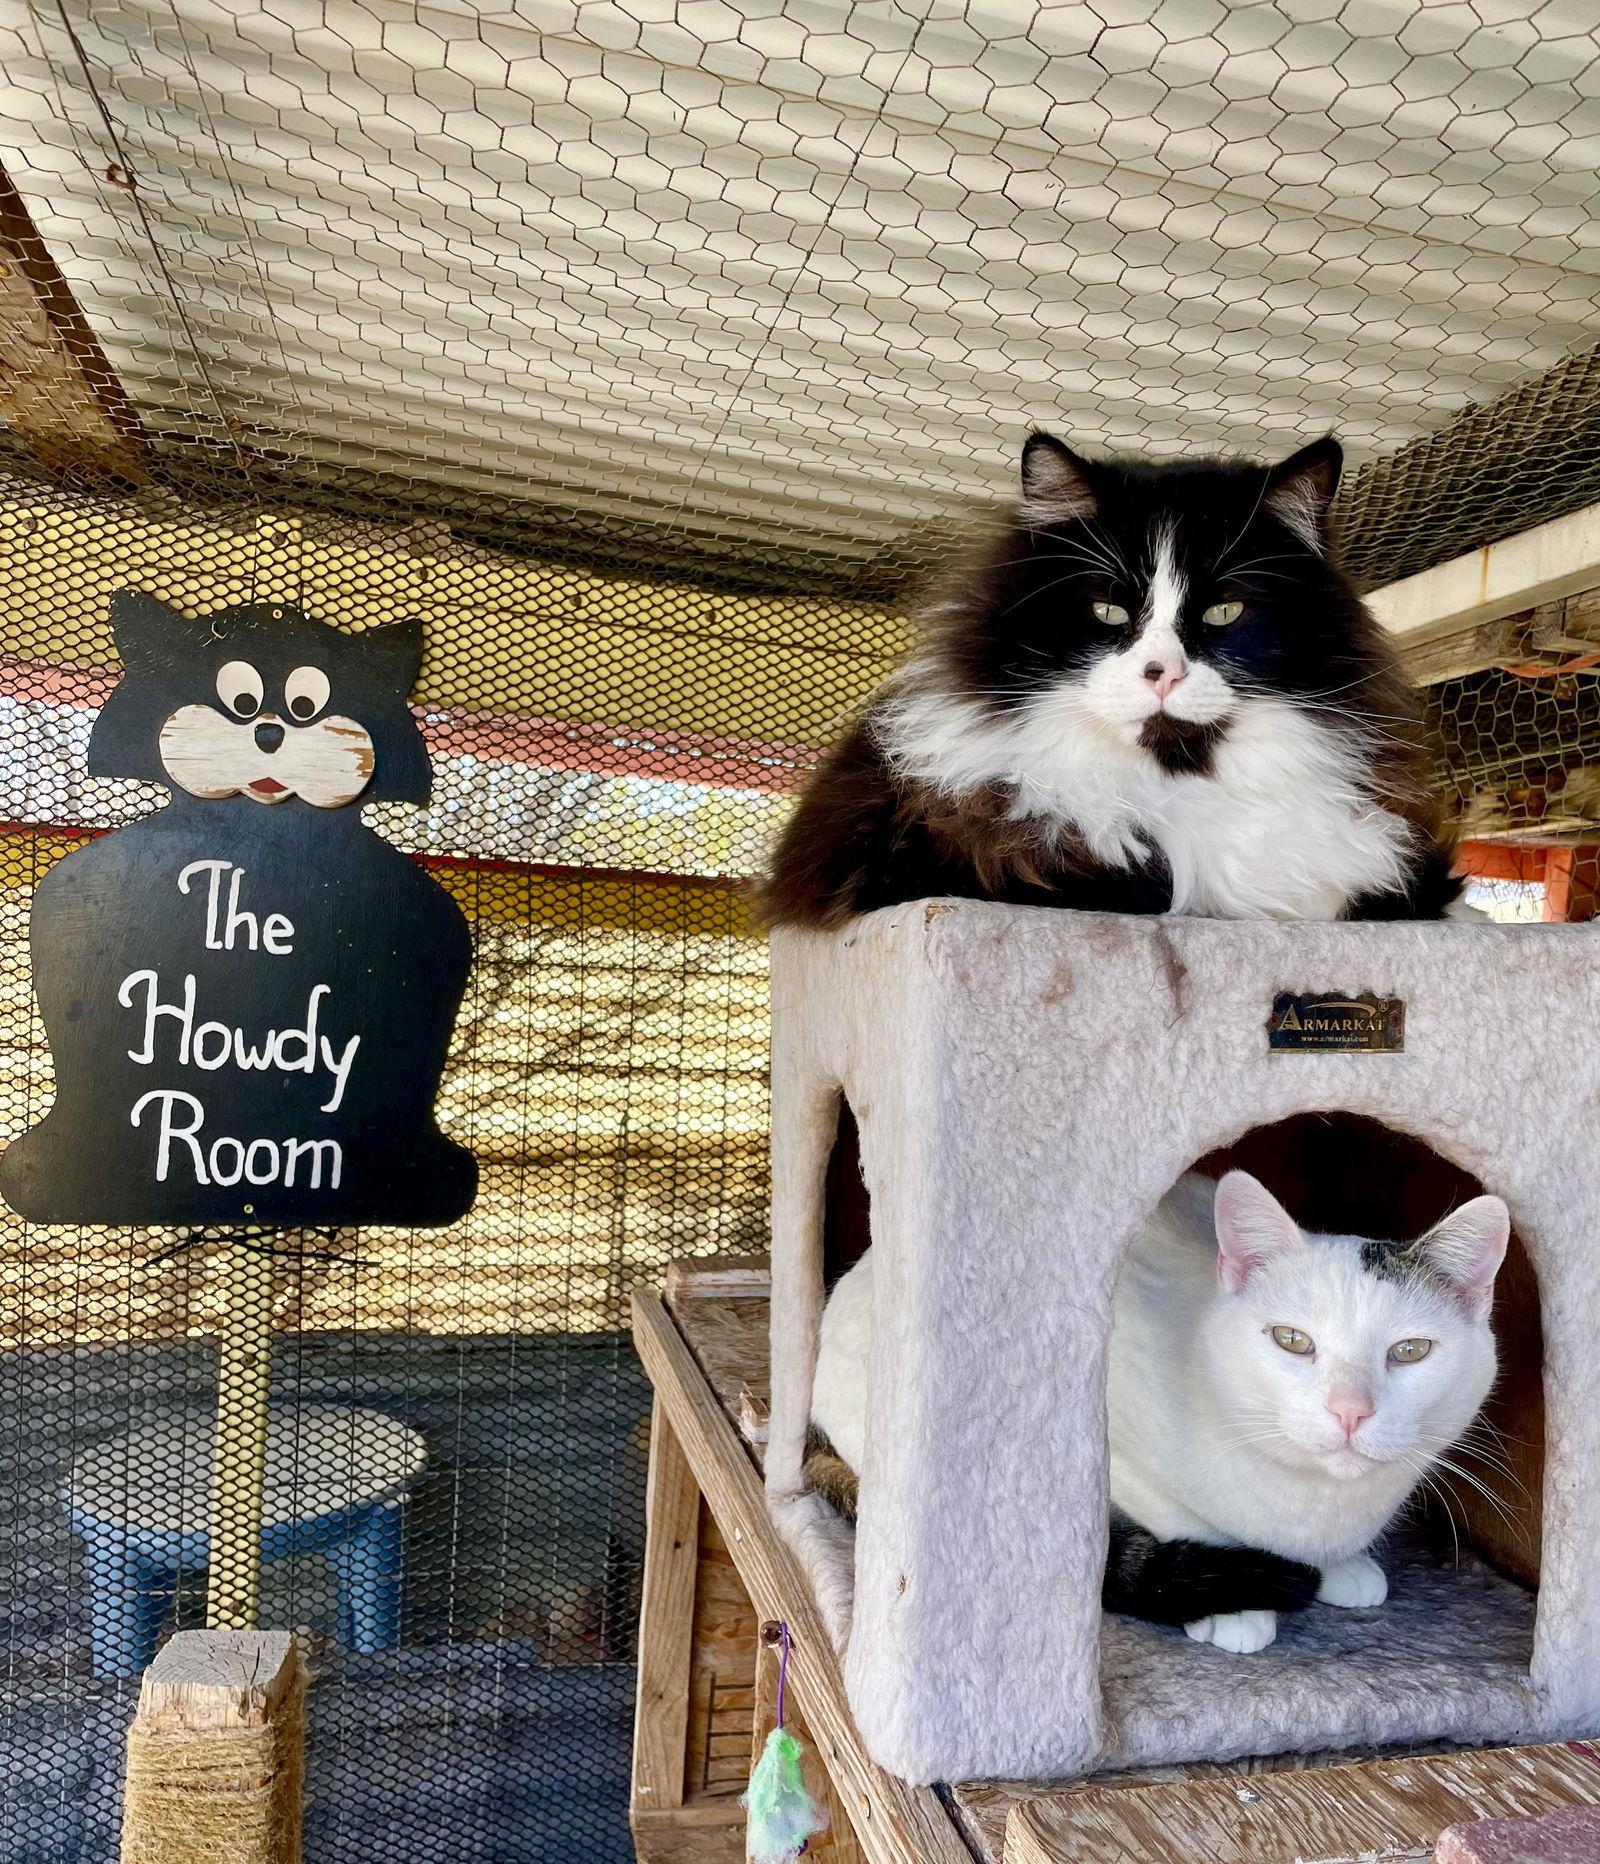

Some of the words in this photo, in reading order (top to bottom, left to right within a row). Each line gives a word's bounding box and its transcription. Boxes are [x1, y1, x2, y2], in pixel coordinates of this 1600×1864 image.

[177, 859, 295, 955] The
[117, 969, 361, 1113] Howdy
[130, 1089, 343, 1190] Room
